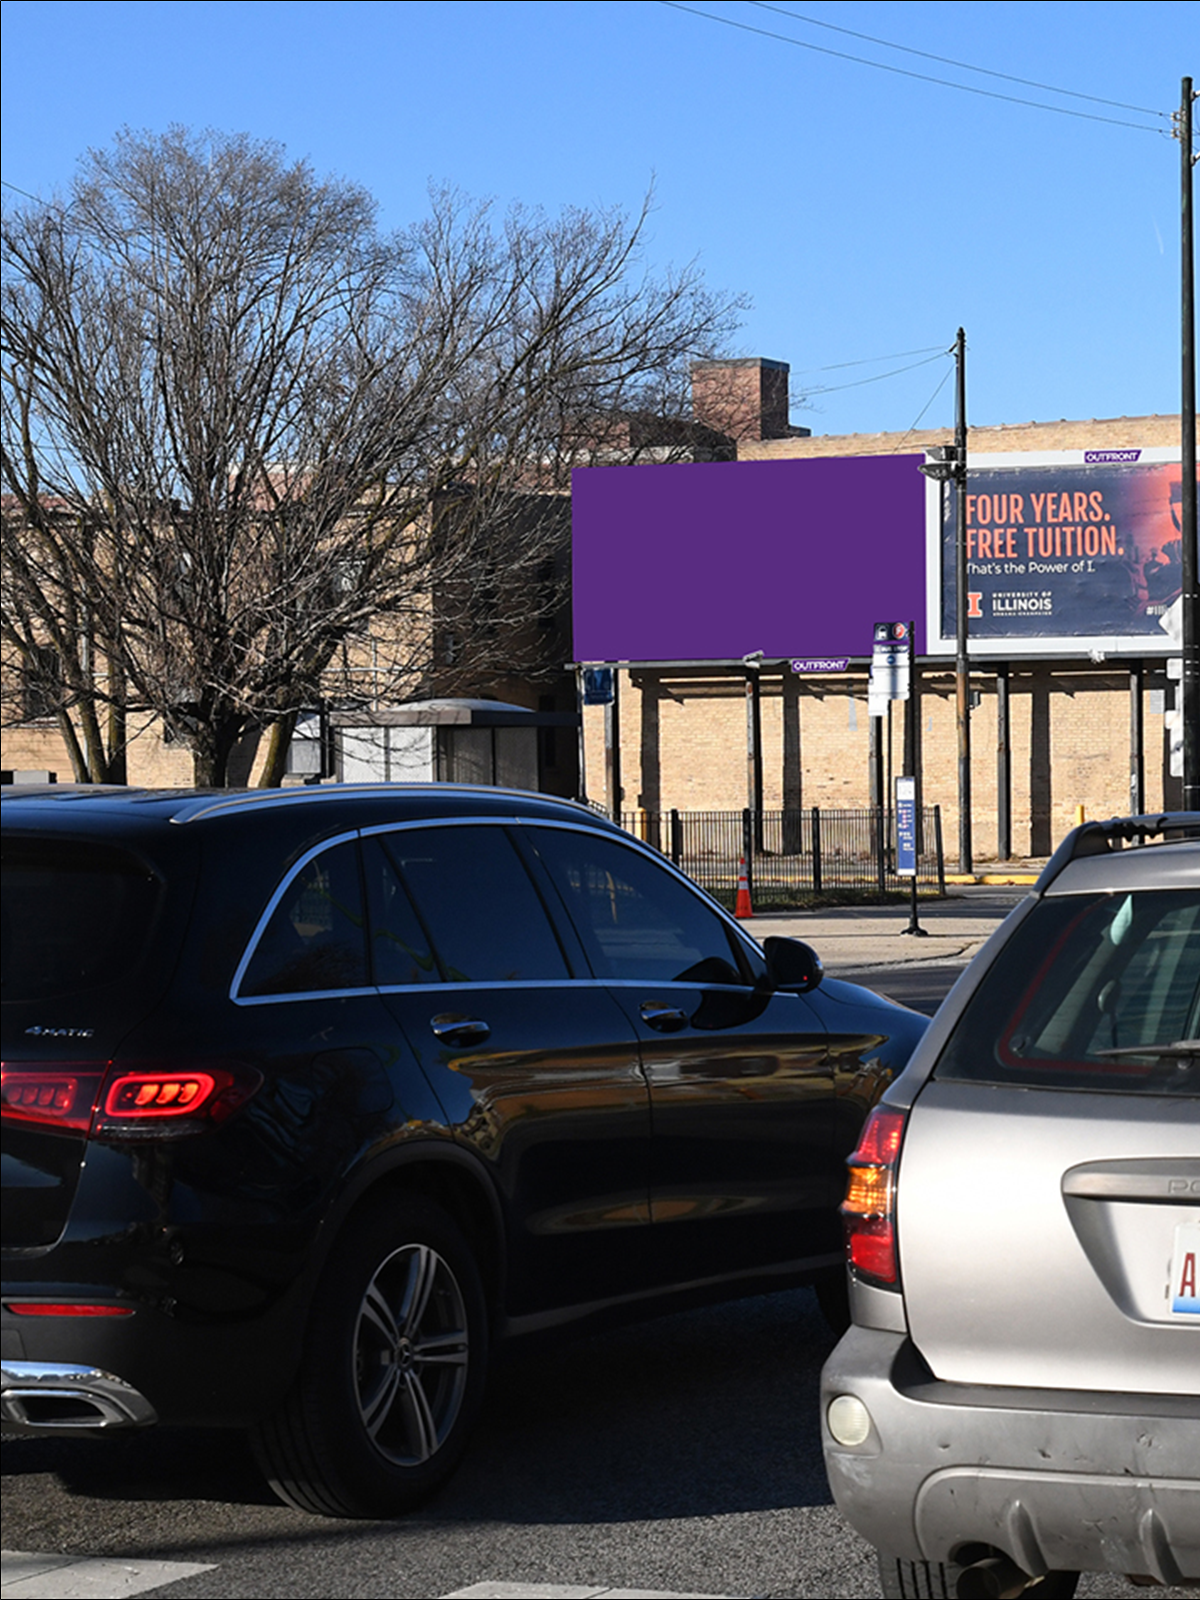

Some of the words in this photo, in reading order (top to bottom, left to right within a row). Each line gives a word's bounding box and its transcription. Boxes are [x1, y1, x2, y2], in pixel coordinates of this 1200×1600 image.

[1086, 452, 1138, 462] OUTFRONT
[966, 493, 1024, 525] FOUR
[1030, 491, 1111, 523] YEARS.
[966, 528, 1018, 559] FREE
[1023, 525, 1125, 558] TUITION.
[1004, 562, 1026, 574] the
[1028, 561, 1069, 574] Power
[1071, 560, 1085, 573] of
[992, 598, 1052, 611] ILLINOIS
[794, 660, 846, 671] OUTFRONT
